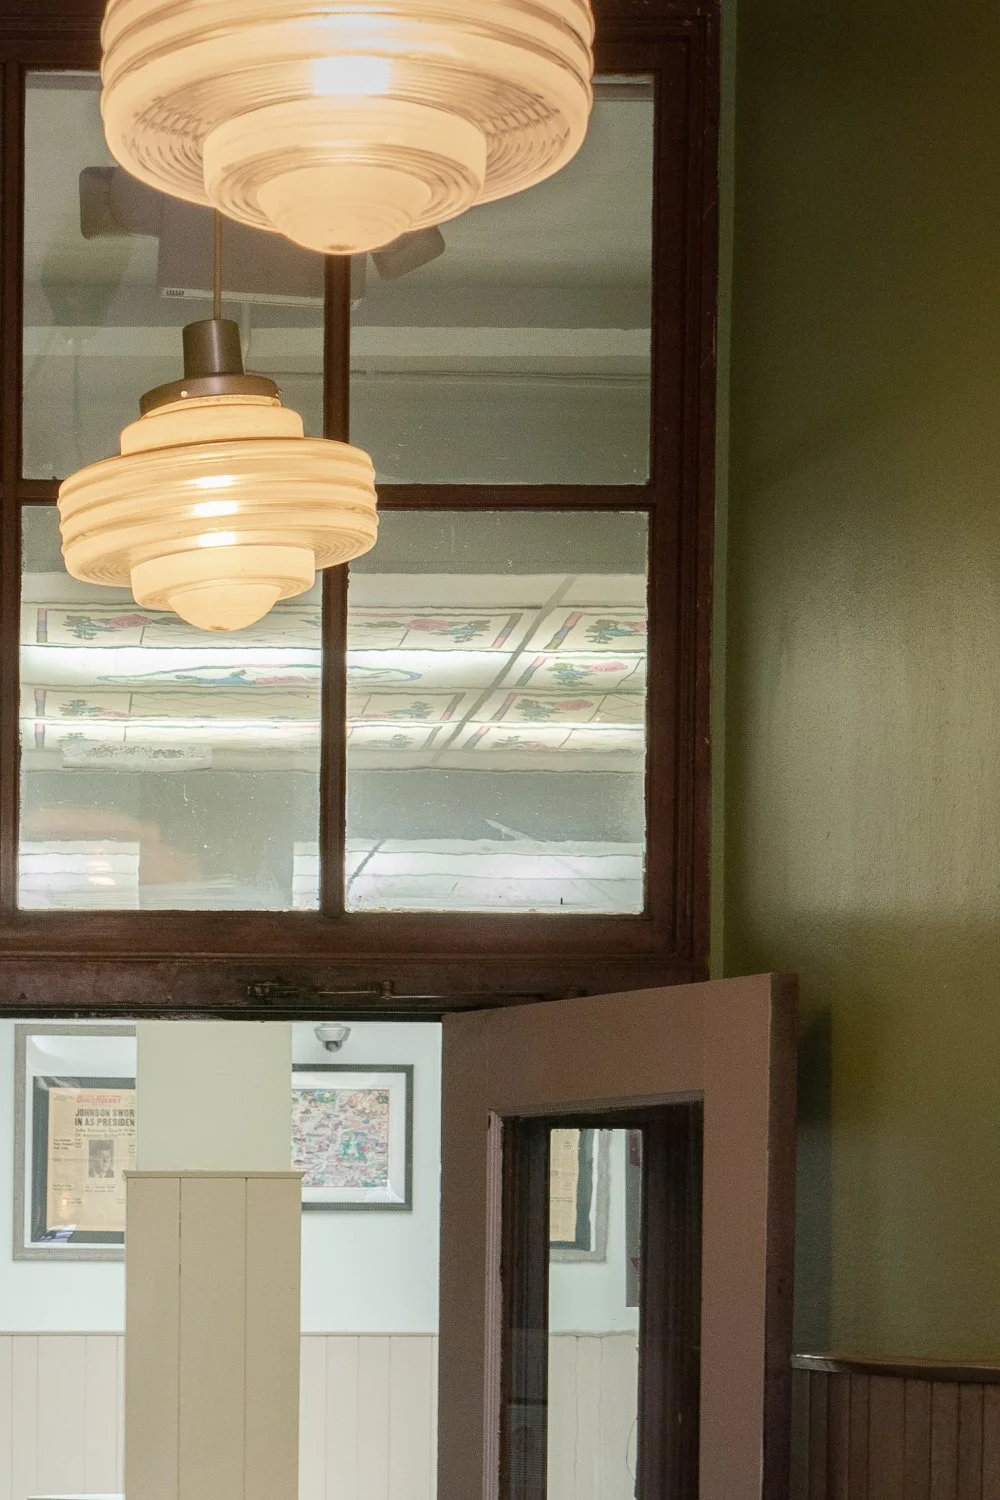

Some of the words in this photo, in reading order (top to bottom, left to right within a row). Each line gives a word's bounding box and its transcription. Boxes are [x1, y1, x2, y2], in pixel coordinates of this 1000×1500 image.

[75, 1108, 110, 1117] JOHNSON
[112, 1108, 135, 1117] SWOR
[74, 1117, 83, 1126] IN
[85, 1117, 95, 1126] AS
[97, 1117, 135, 1126] PRESIDEN
